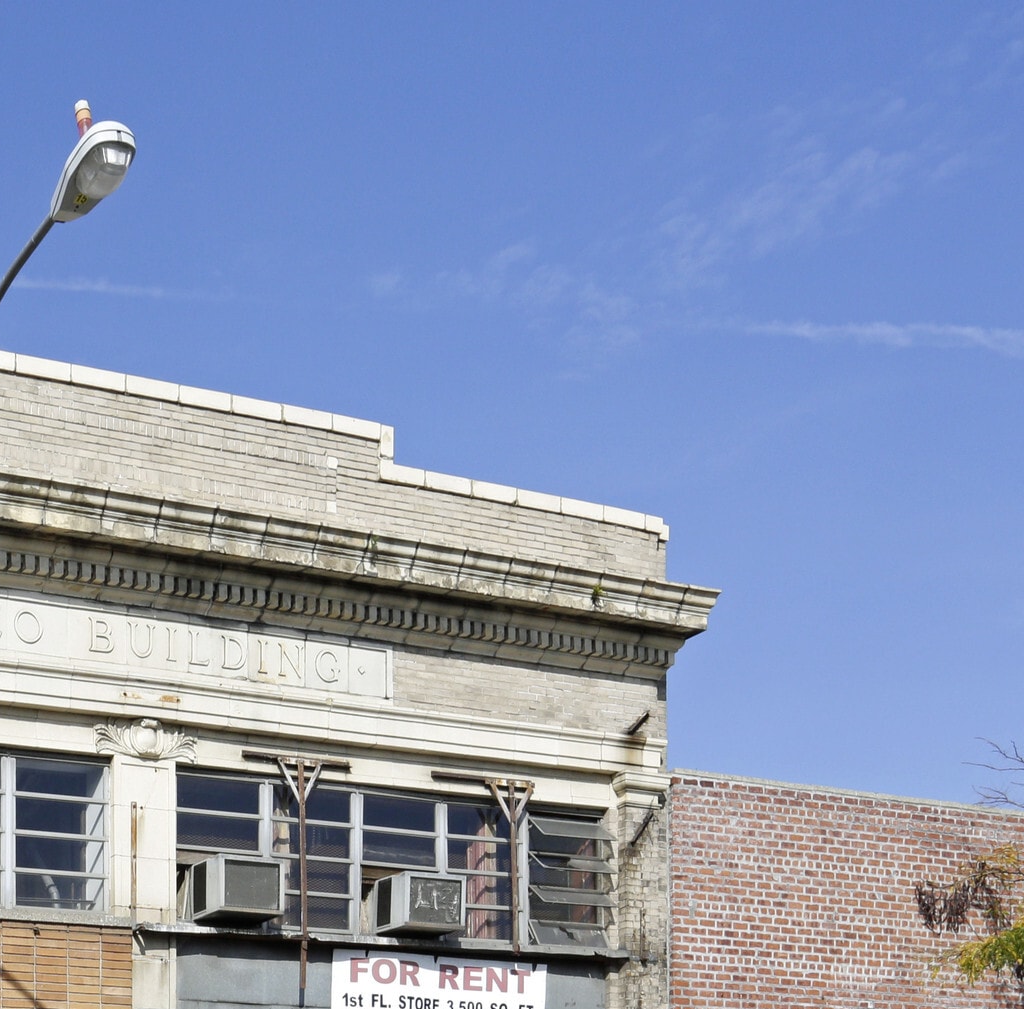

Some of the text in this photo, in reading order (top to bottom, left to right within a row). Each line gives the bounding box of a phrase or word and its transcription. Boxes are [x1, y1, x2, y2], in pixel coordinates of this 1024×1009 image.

[89, 616, 341, 685] BUILDING
[349, 957, 531, 994] FOR RENT
[342, 993, 363, 1008] 1st
[371, 994, 391, 1008] FL.
